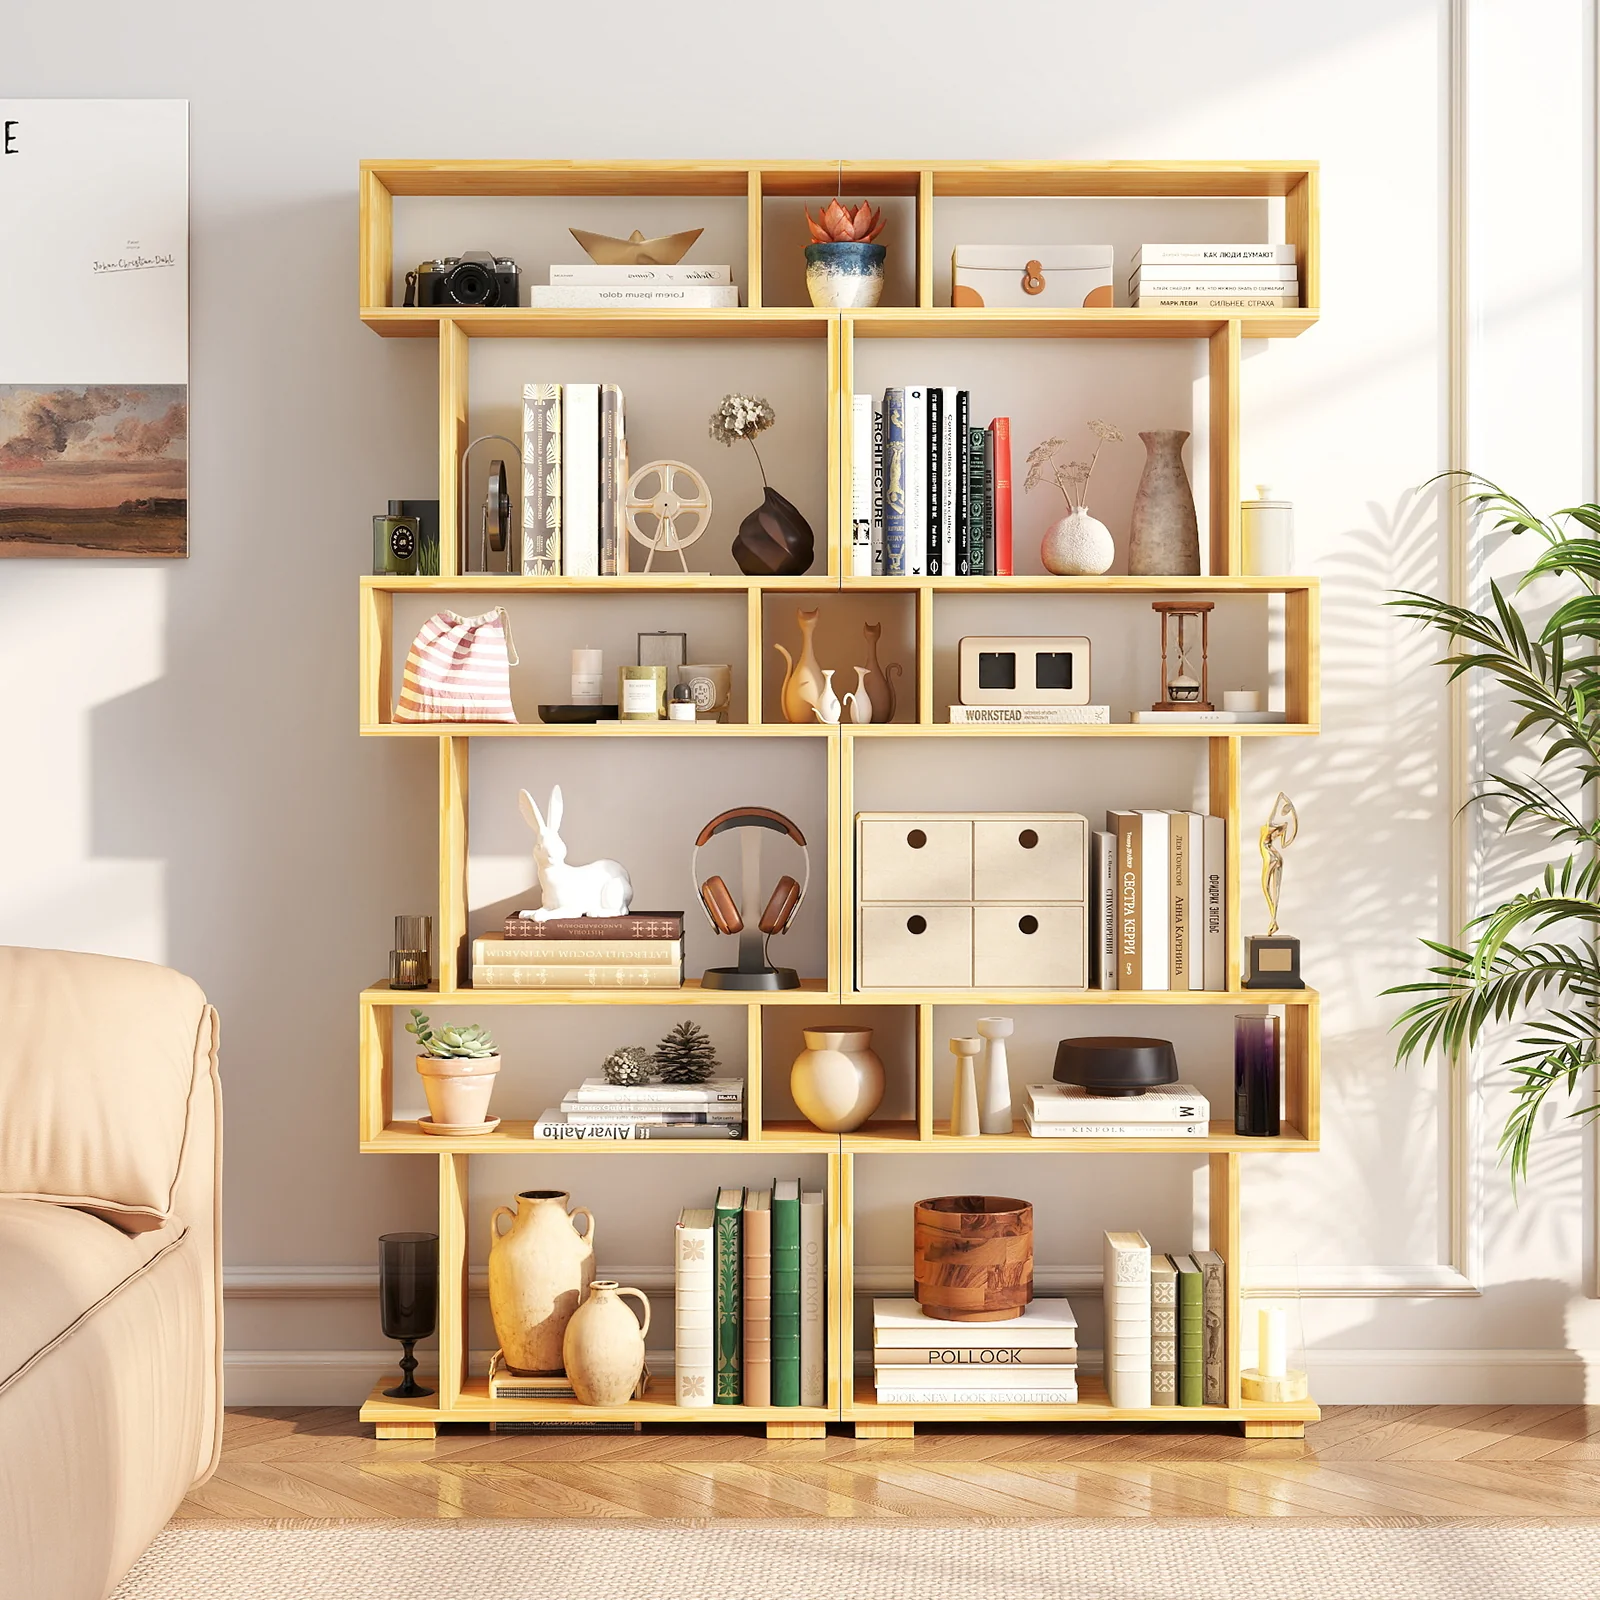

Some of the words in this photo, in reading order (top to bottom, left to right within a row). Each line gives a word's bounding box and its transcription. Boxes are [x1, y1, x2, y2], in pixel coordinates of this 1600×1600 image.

[5, 121, 19, 154] E
[874, 411, 883, 528] ARCHITECTURE
[985, 495, 993, 539] architecture
[965, 709, 1022, 721] WORKSTEAD
[1123, 871, 1136, 916] СЕСТРА
[1209, 874, 1220, 904] ФРИДРИХ
[1105, 888, 1114, 955] СТИХОТВОРЕНИЯ
[1209, 906, 1220, 934] ЭНГЕЛЬС
[1123, 918, 1136, 955] КЕРРИ
[486, 950, 555, 958] LATINARUM
[558, 950, 603, 958] VOCUM
[605, 950, 669, 958] LATERCULI
[1179, 1106, 1195, 1117] M
[806, 1241, 818, 1322] LUXDECO
[928, 1349, 1022, 1364] POLLOCK
[922, 1393, 948, 1402] NEW
[953, 1393, 986, 1402] LOOK
[986, 1393, 1068, 1402] REVOLUTION
